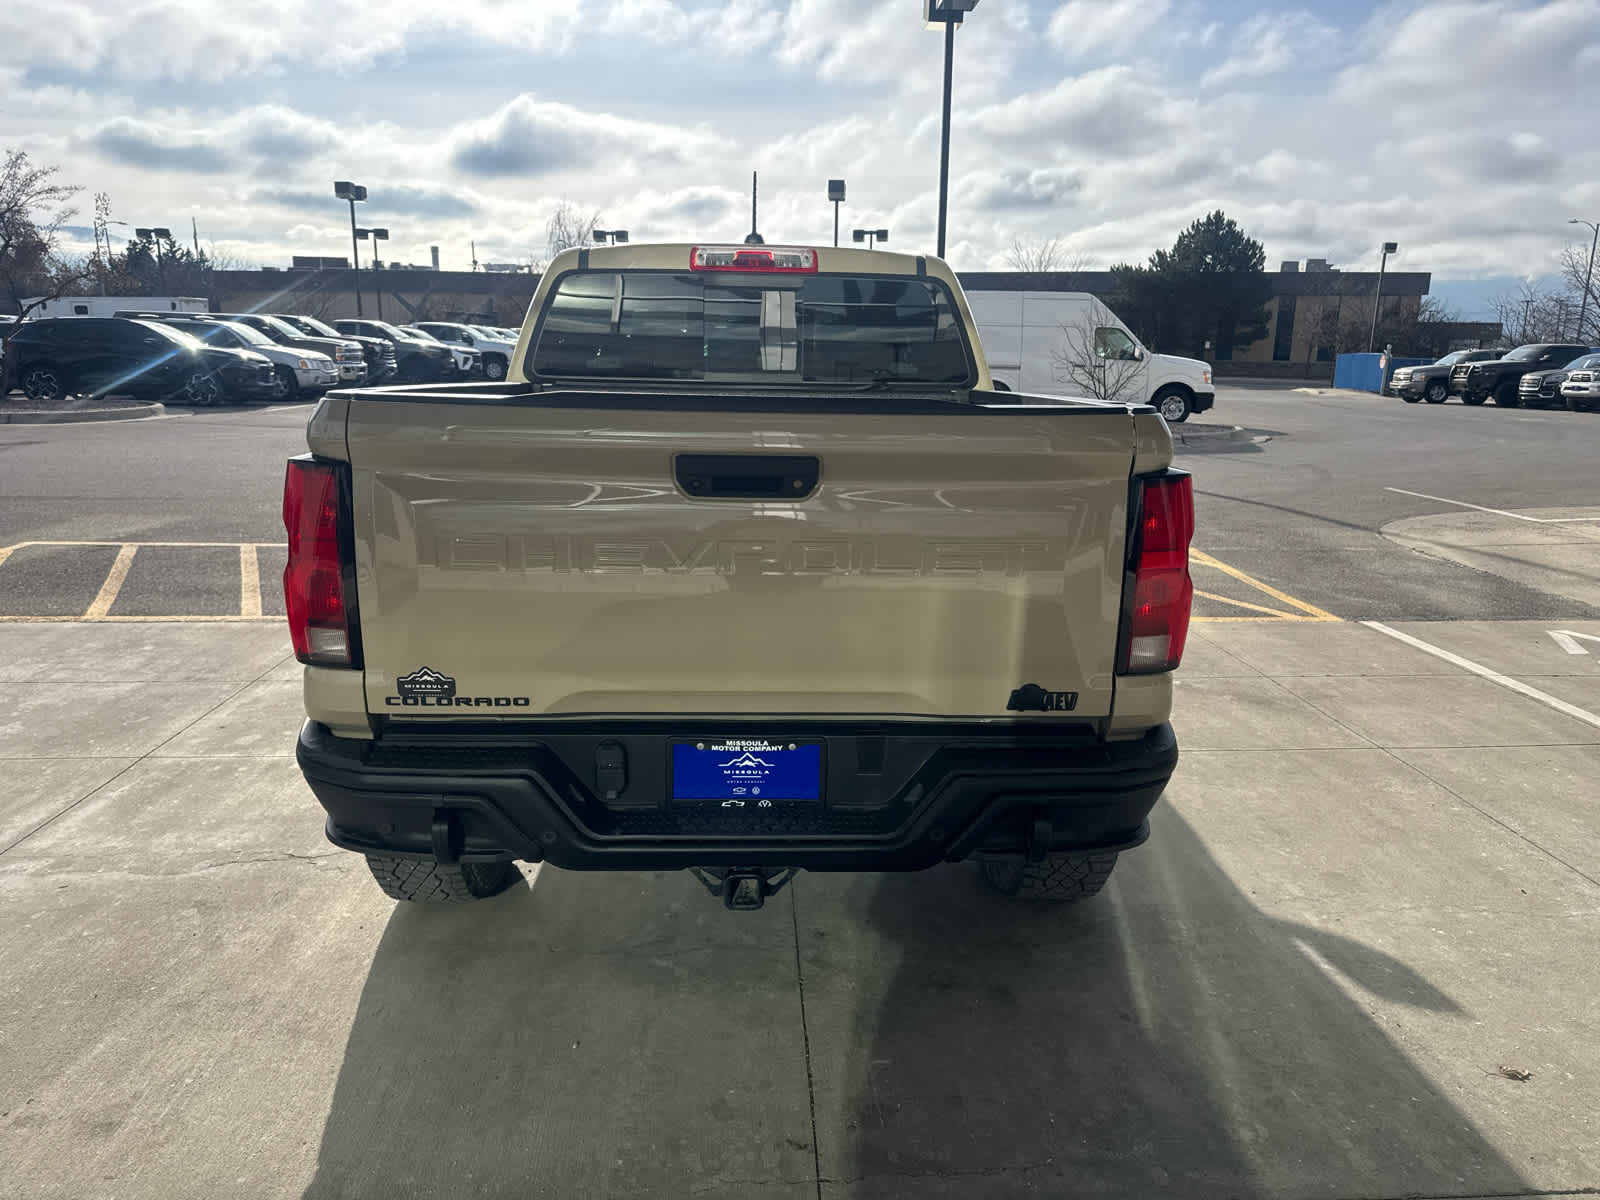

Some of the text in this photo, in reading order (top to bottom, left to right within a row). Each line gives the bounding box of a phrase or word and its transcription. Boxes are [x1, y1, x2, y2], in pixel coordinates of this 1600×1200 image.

[435, 535, 1052, 576] CHEVROLET
[385, 696, 530, 706] COLORADO
[1047, 691, 1078, 711] AEV
